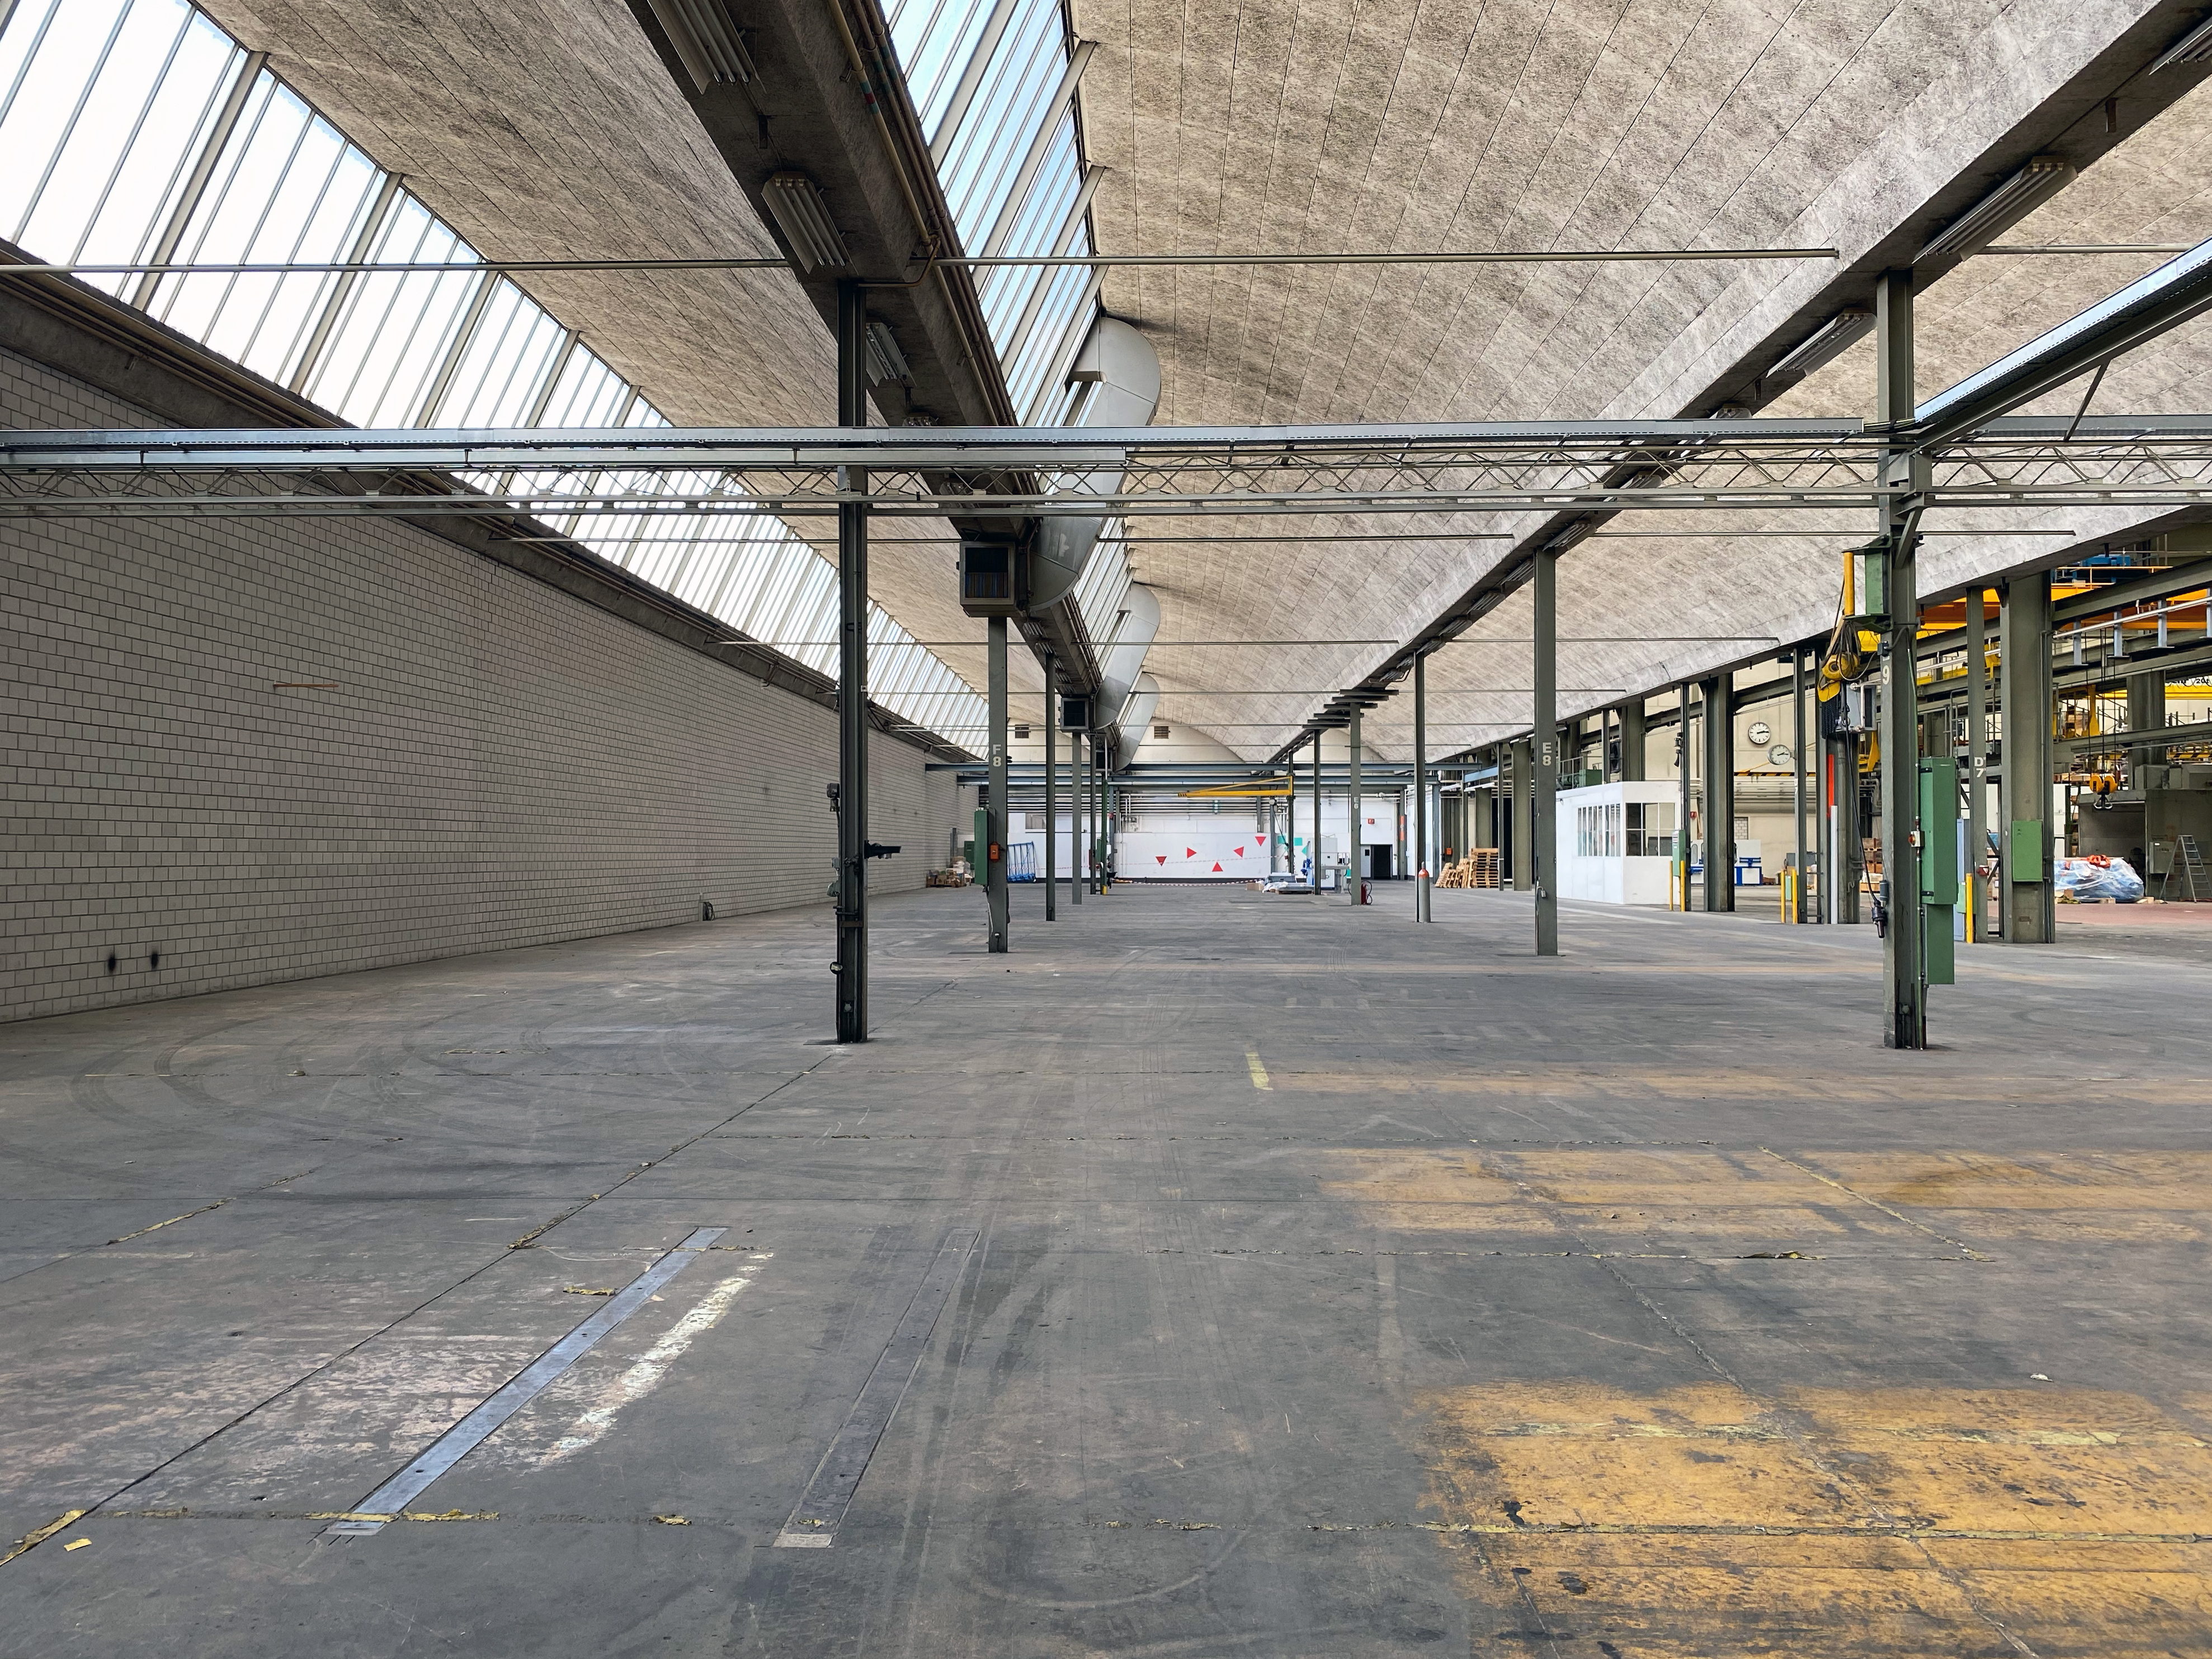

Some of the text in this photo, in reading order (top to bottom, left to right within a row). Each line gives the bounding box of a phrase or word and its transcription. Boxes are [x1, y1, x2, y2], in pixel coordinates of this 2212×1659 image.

[1883, 665, 1890, 685] 9
[993, 744, 1001, 755] F
[1543, 742, 1551, 753] E
[993, 756, 1001, 767] 8
[1543, 755, 1551, 766] 8
[1974, 757, 1983, 766] D
[1976, 768, 1984, 777] 7
